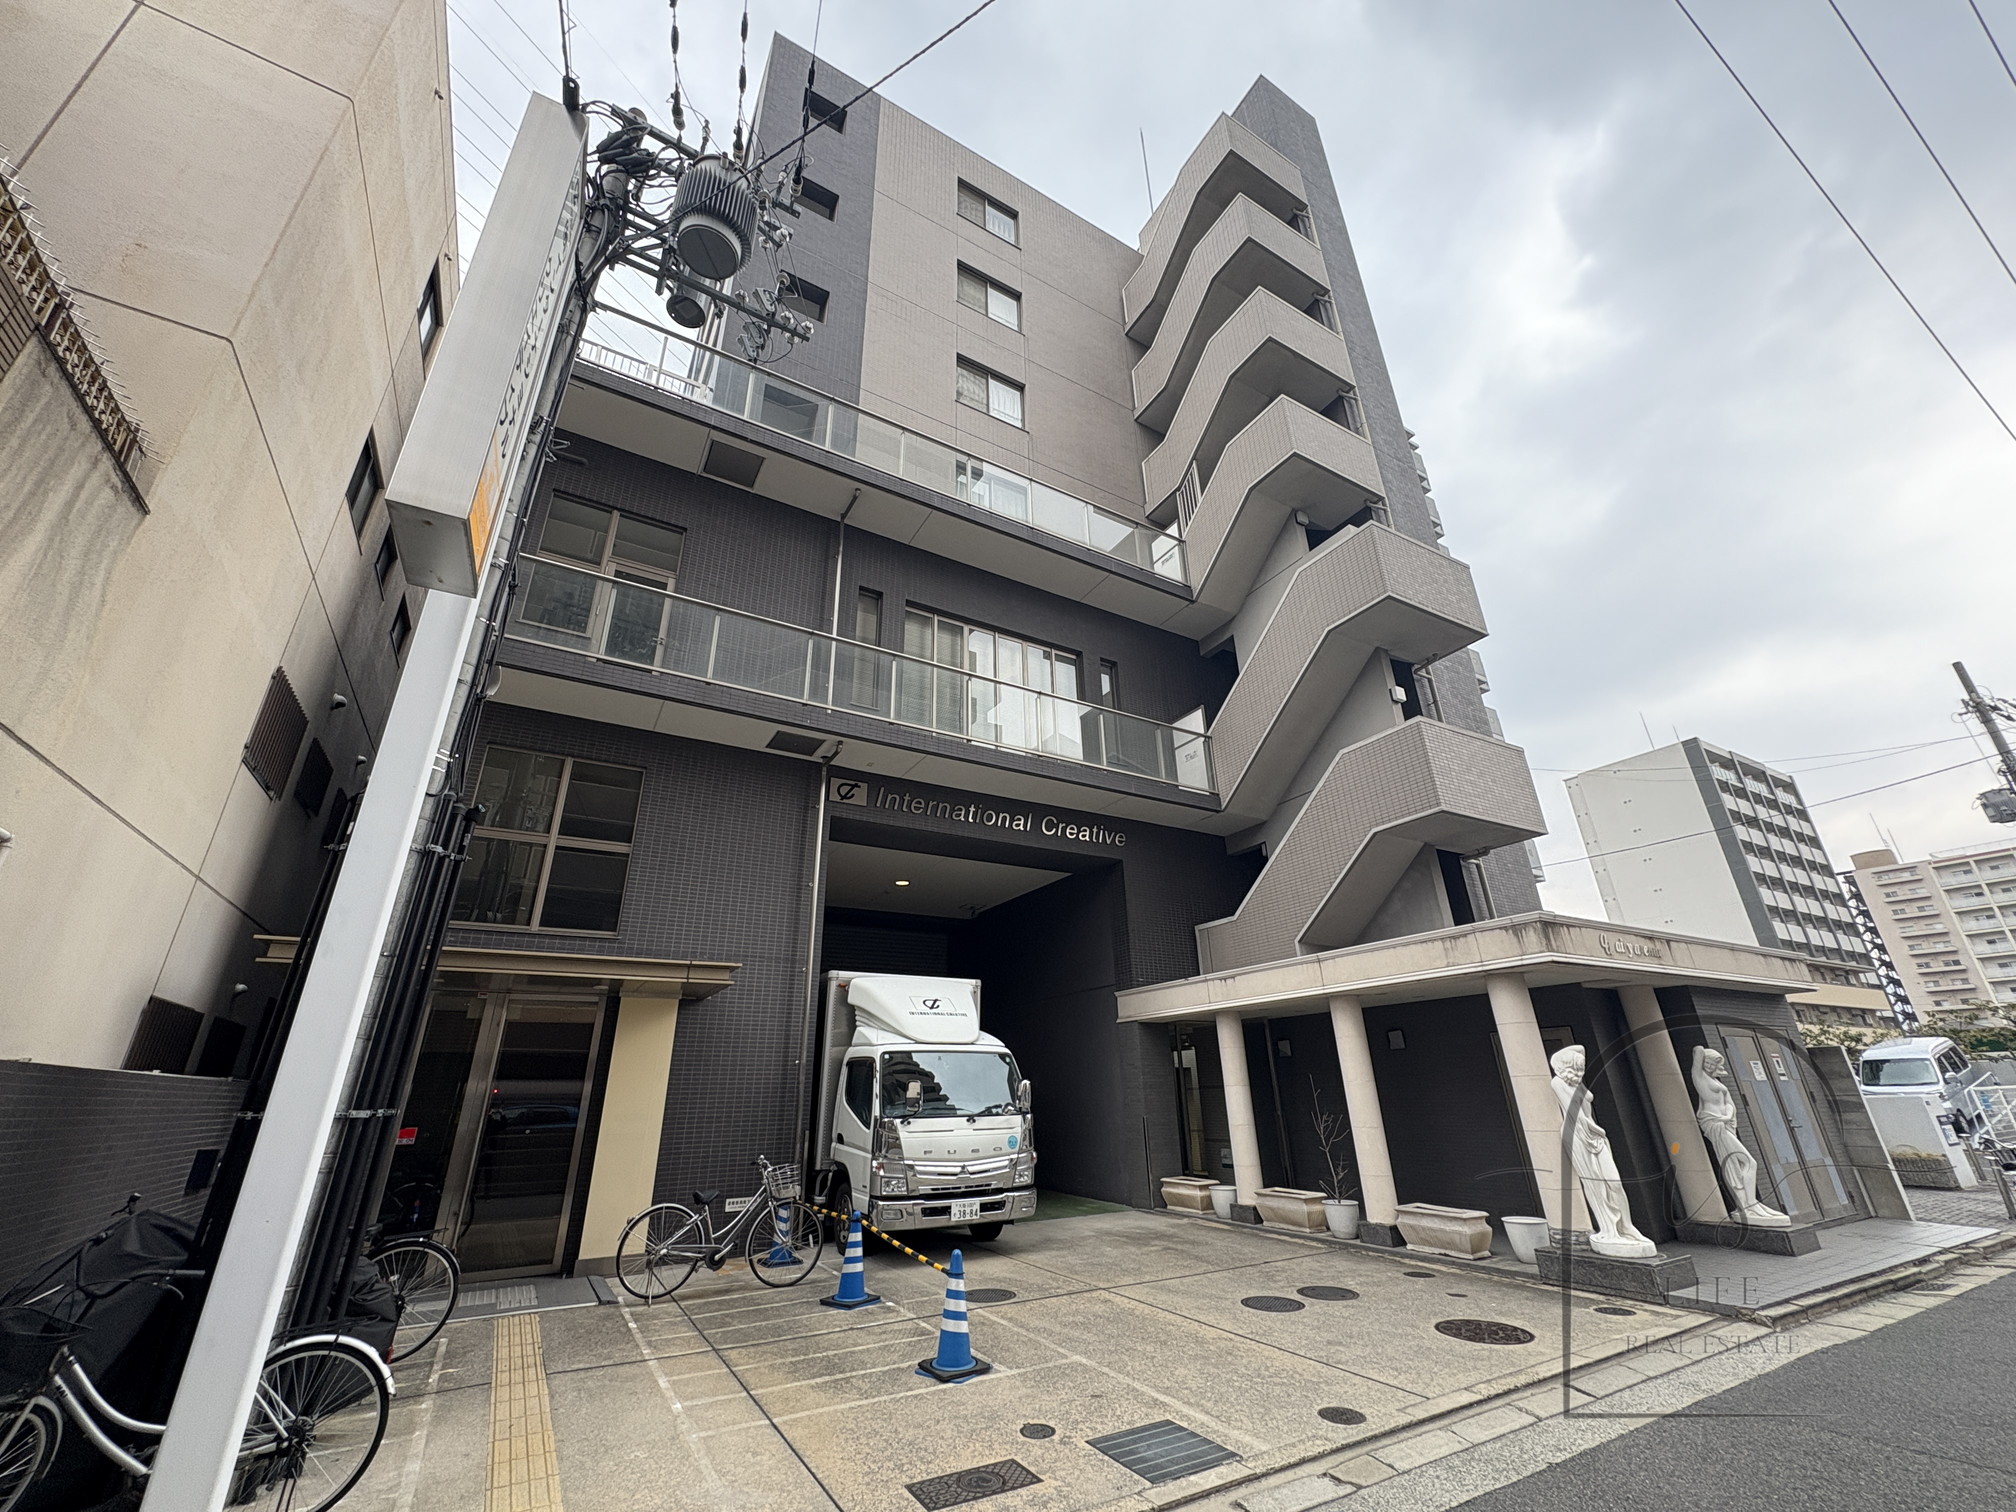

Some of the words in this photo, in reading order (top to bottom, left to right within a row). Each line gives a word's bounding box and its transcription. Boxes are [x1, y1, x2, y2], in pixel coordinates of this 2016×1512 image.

[876, 786, 1032, 832] International
[1041, 816, 1126, 847] Creative
[957, 1208, 978, 1219] 38-84
